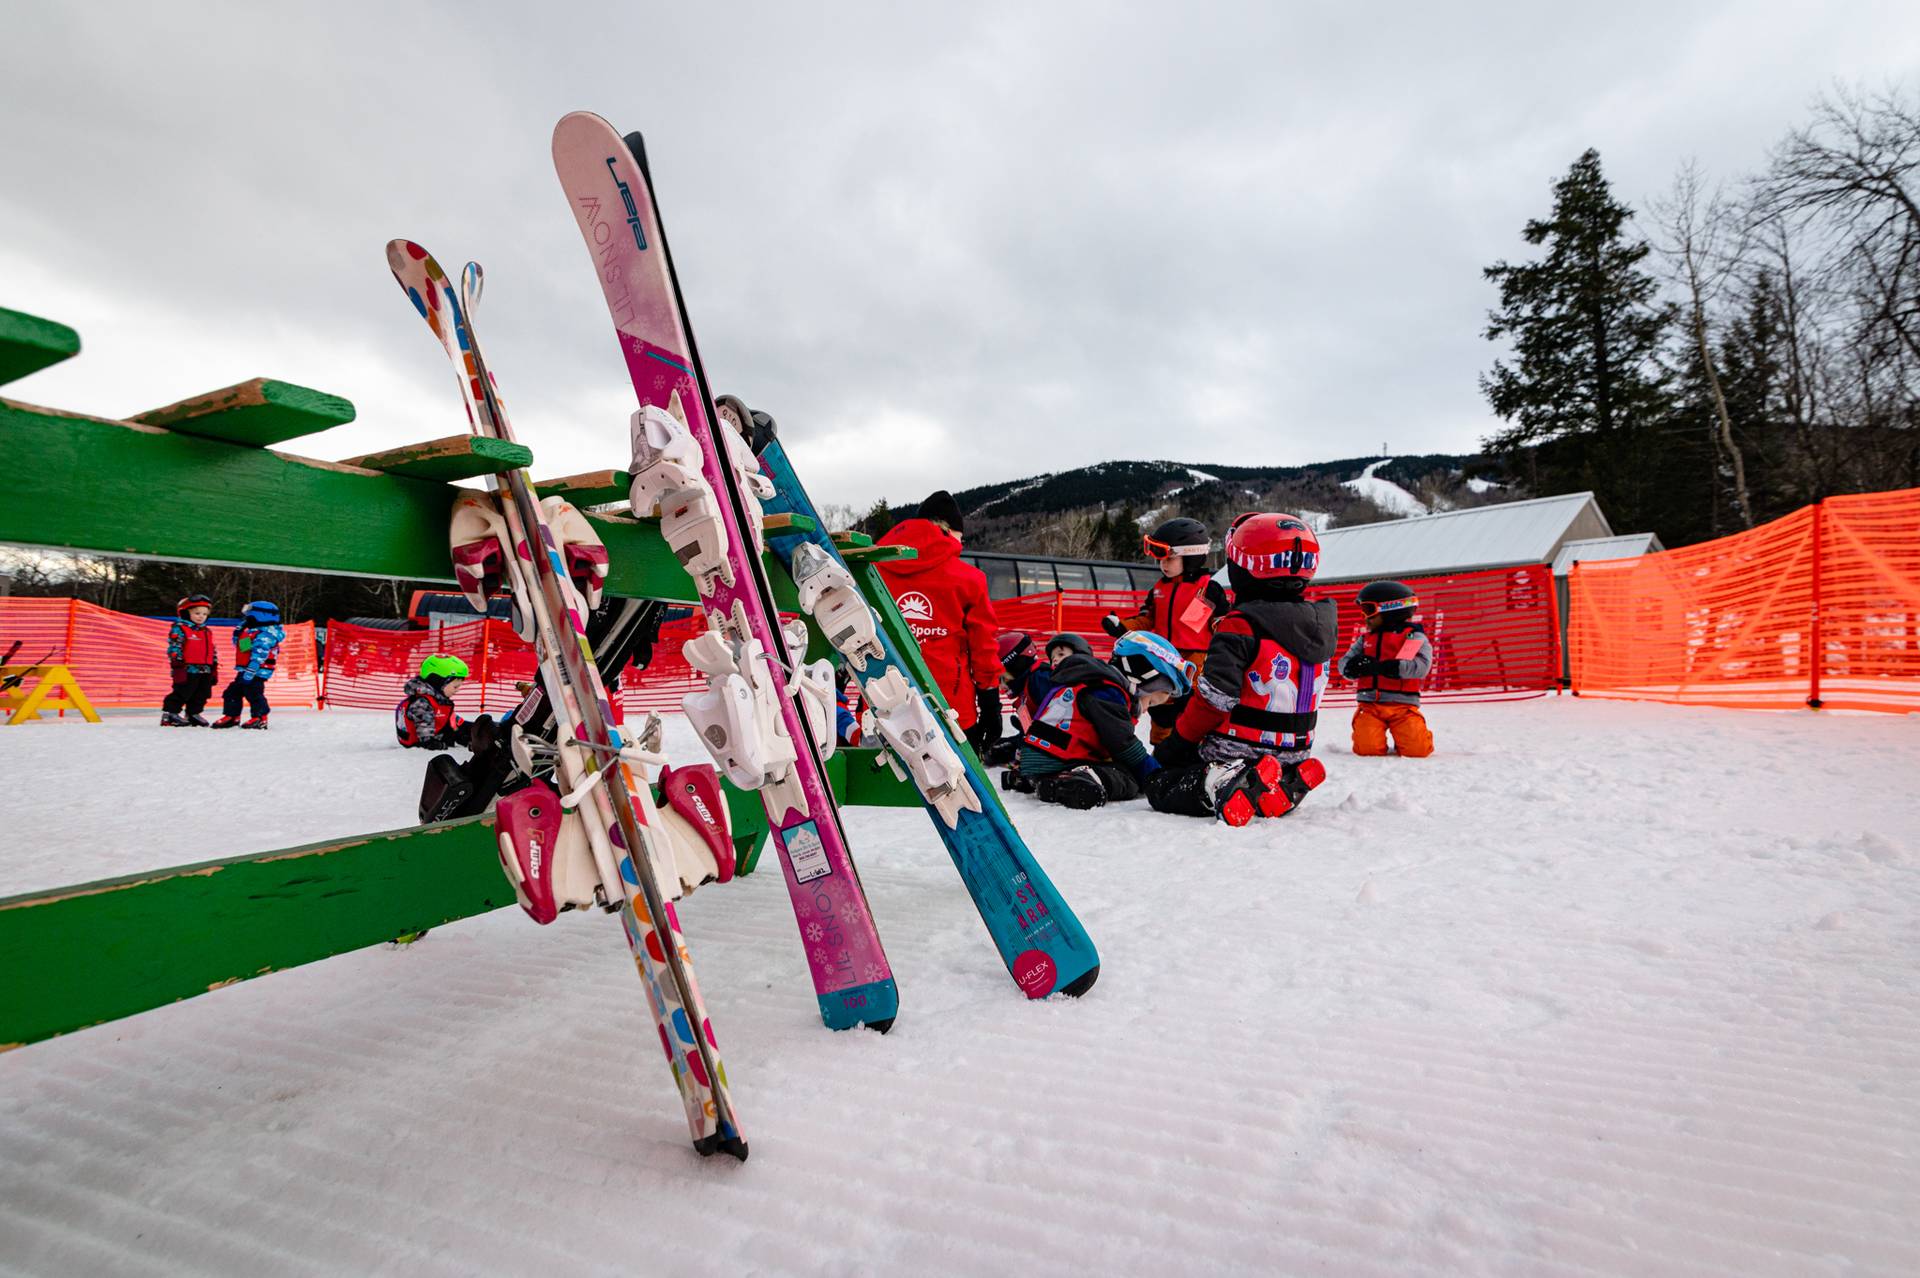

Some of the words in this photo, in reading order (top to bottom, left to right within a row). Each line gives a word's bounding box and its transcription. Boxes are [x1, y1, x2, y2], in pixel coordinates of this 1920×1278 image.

[607, 156, 647, 251] elan
[578, 196, 624, 285] SNOW
[909, 623, 948, 637] Sports
[1011, 871, 1027, 885] 100
[843, 994, 867, 1009] 100
